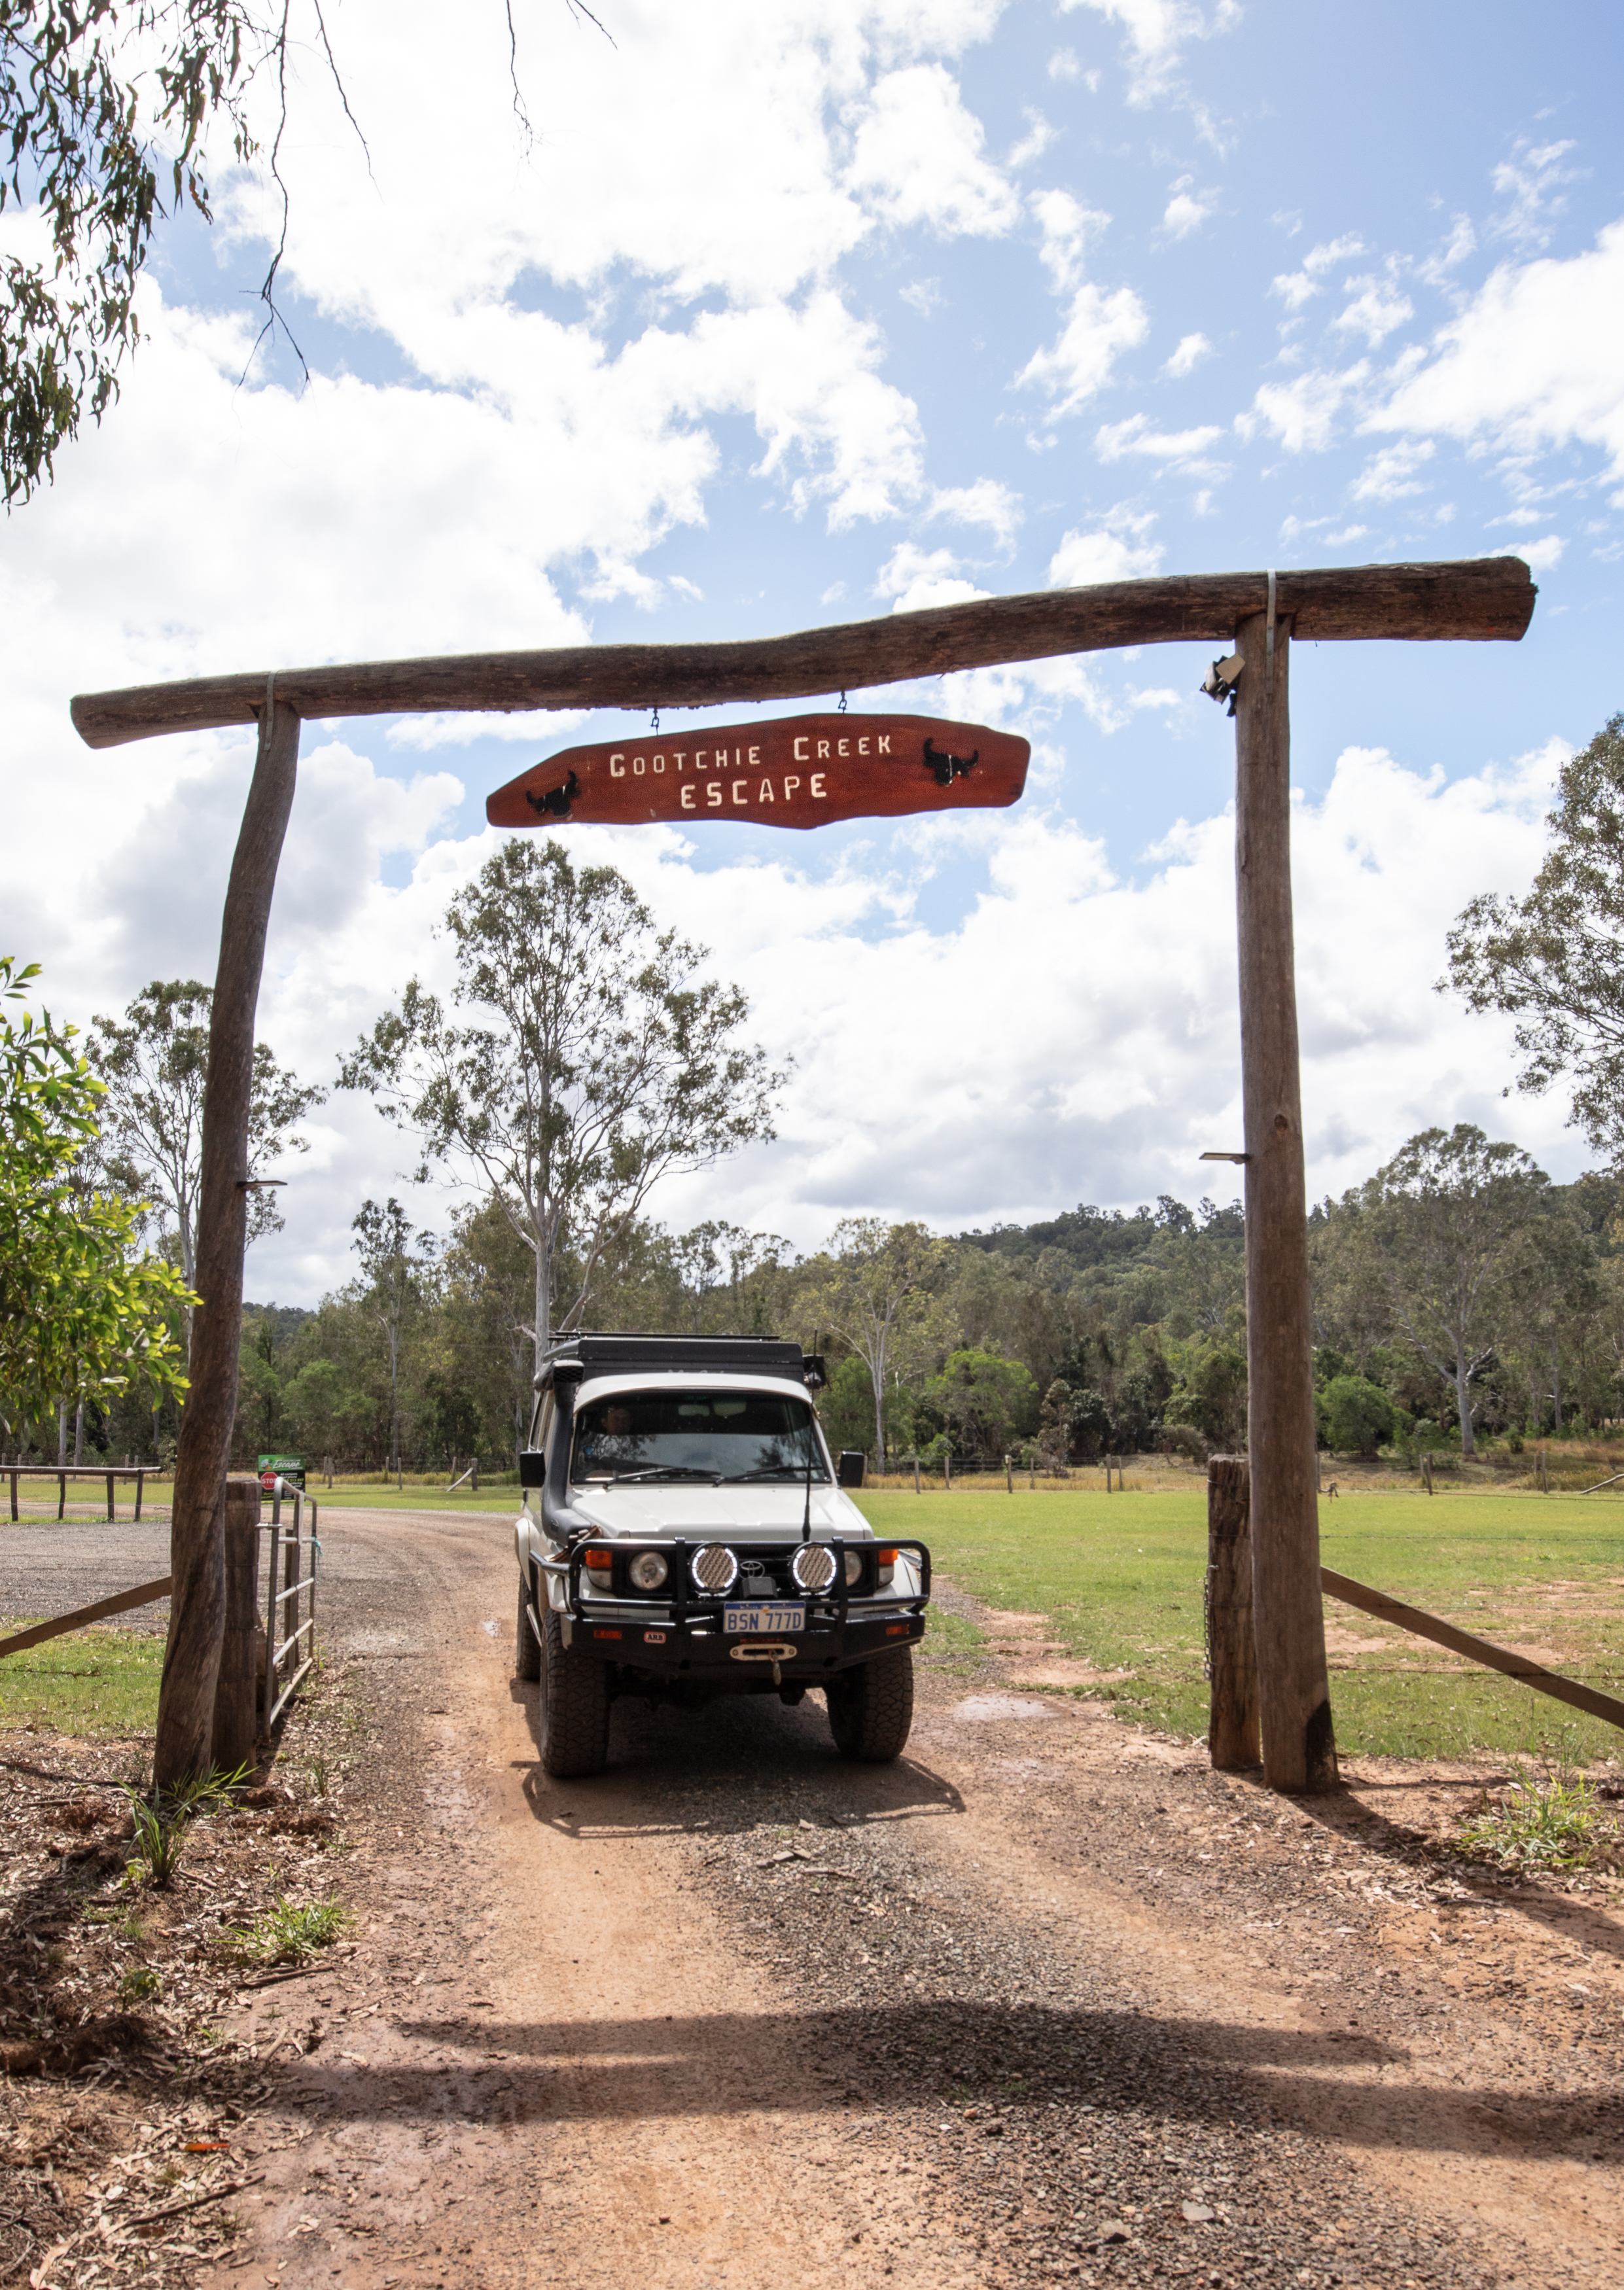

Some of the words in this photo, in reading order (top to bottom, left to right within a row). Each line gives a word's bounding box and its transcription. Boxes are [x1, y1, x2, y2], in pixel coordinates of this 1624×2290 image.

[609, 746, 761, 778] GOOTCHIE
[793, 734, 892, 762] CREEK
[680, 773, 828, 810] ESCAPE
[273, 1459, 300, 1469] Escape
[728, 1613, 759, 1631] BSN
[765, 1612, 802, 1630] 777D
[648, 1633, 663, 1642] ARB
